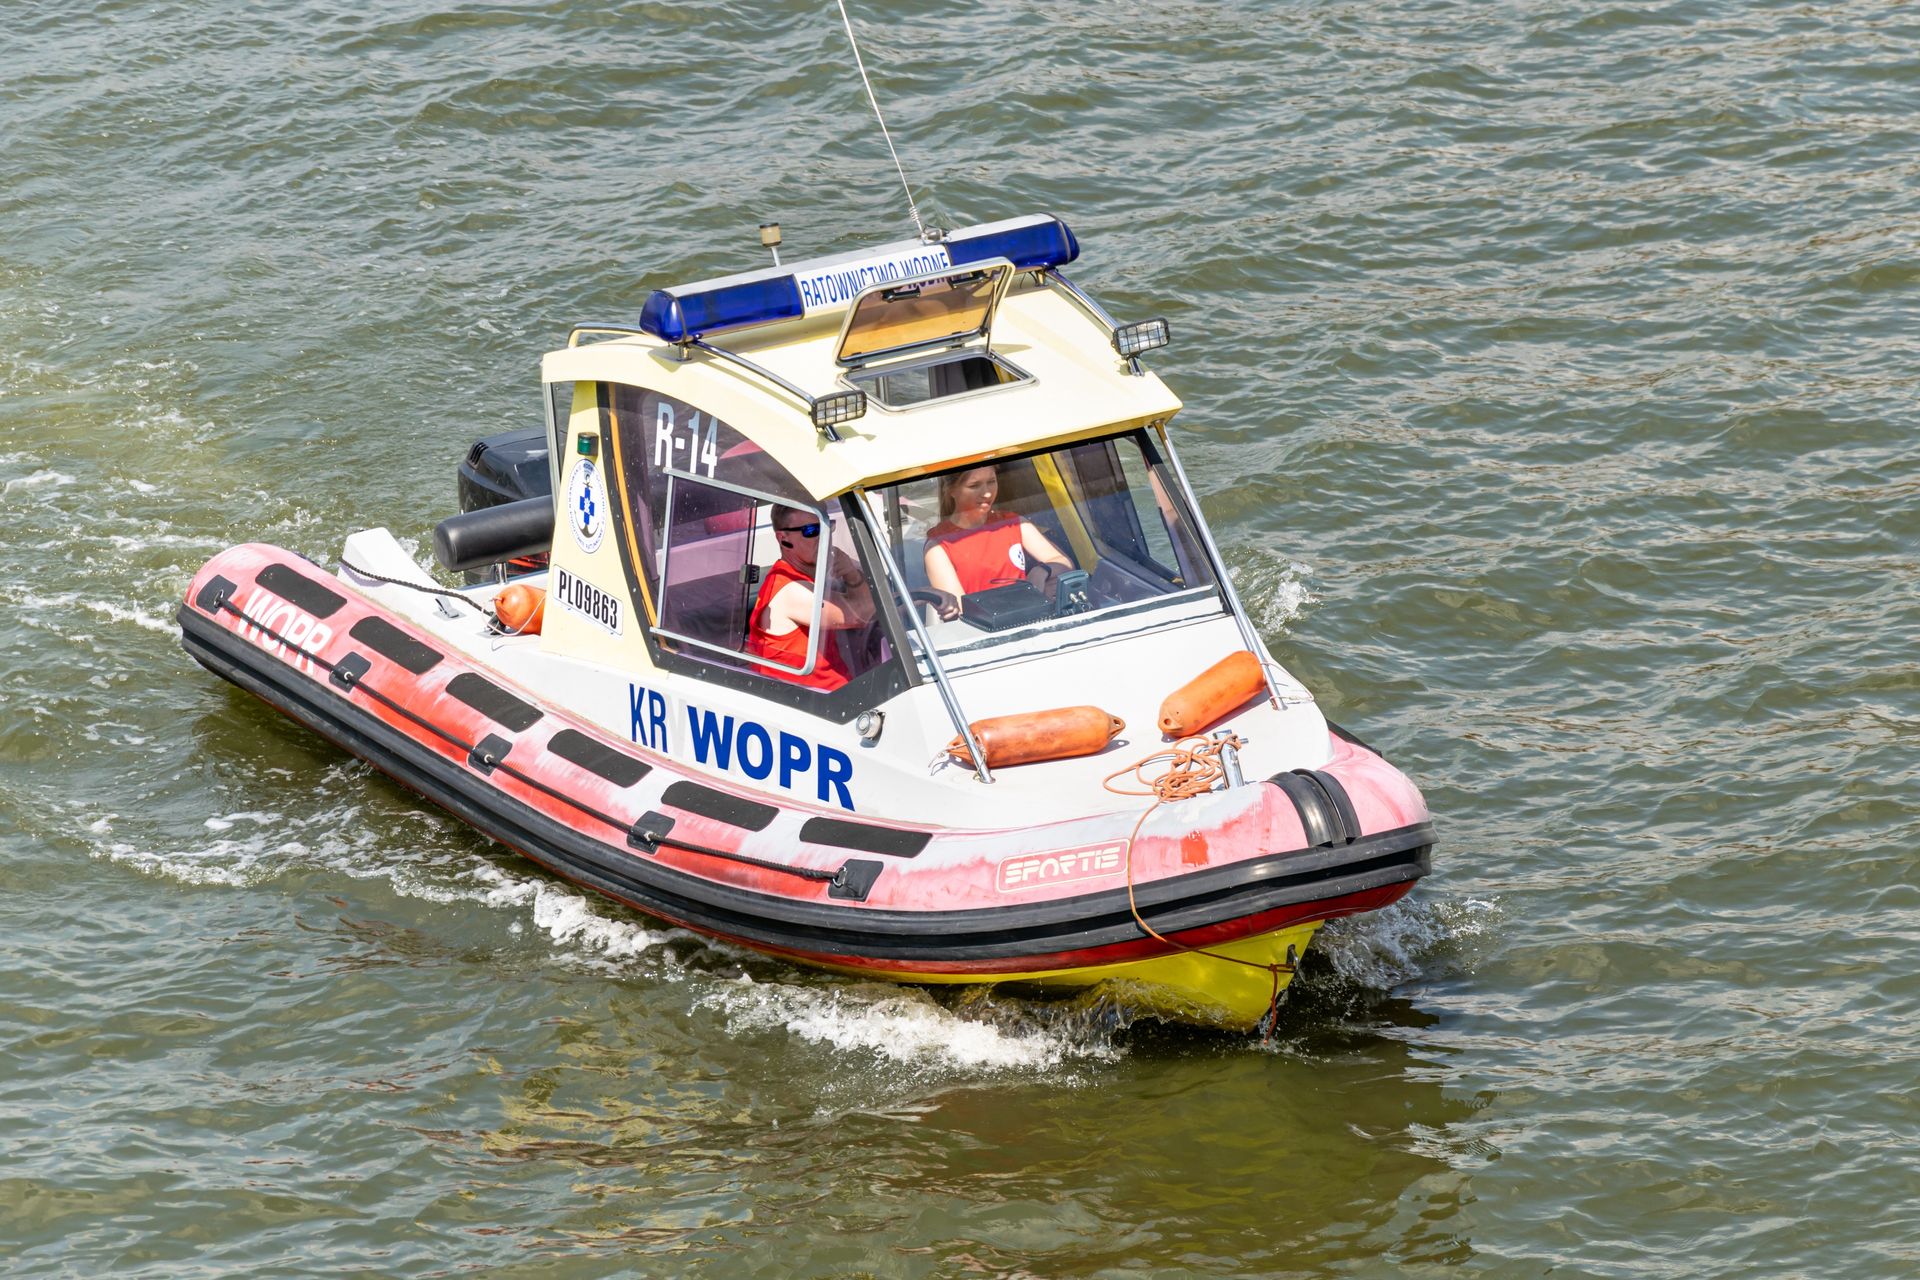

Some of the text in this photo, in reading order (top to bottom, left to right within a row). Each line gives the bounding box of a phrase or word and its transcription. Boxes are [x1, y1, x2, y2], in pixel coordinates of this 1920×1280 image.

[801, 262, 899, 307] RATOWNICTWO
[654, 402, 718, 479] R-14
[237, 588, 333, 675] WOPR
[629, 683, 856, 812] KR WOPR
[1004, 846, 1121, 885] SPORTIS
